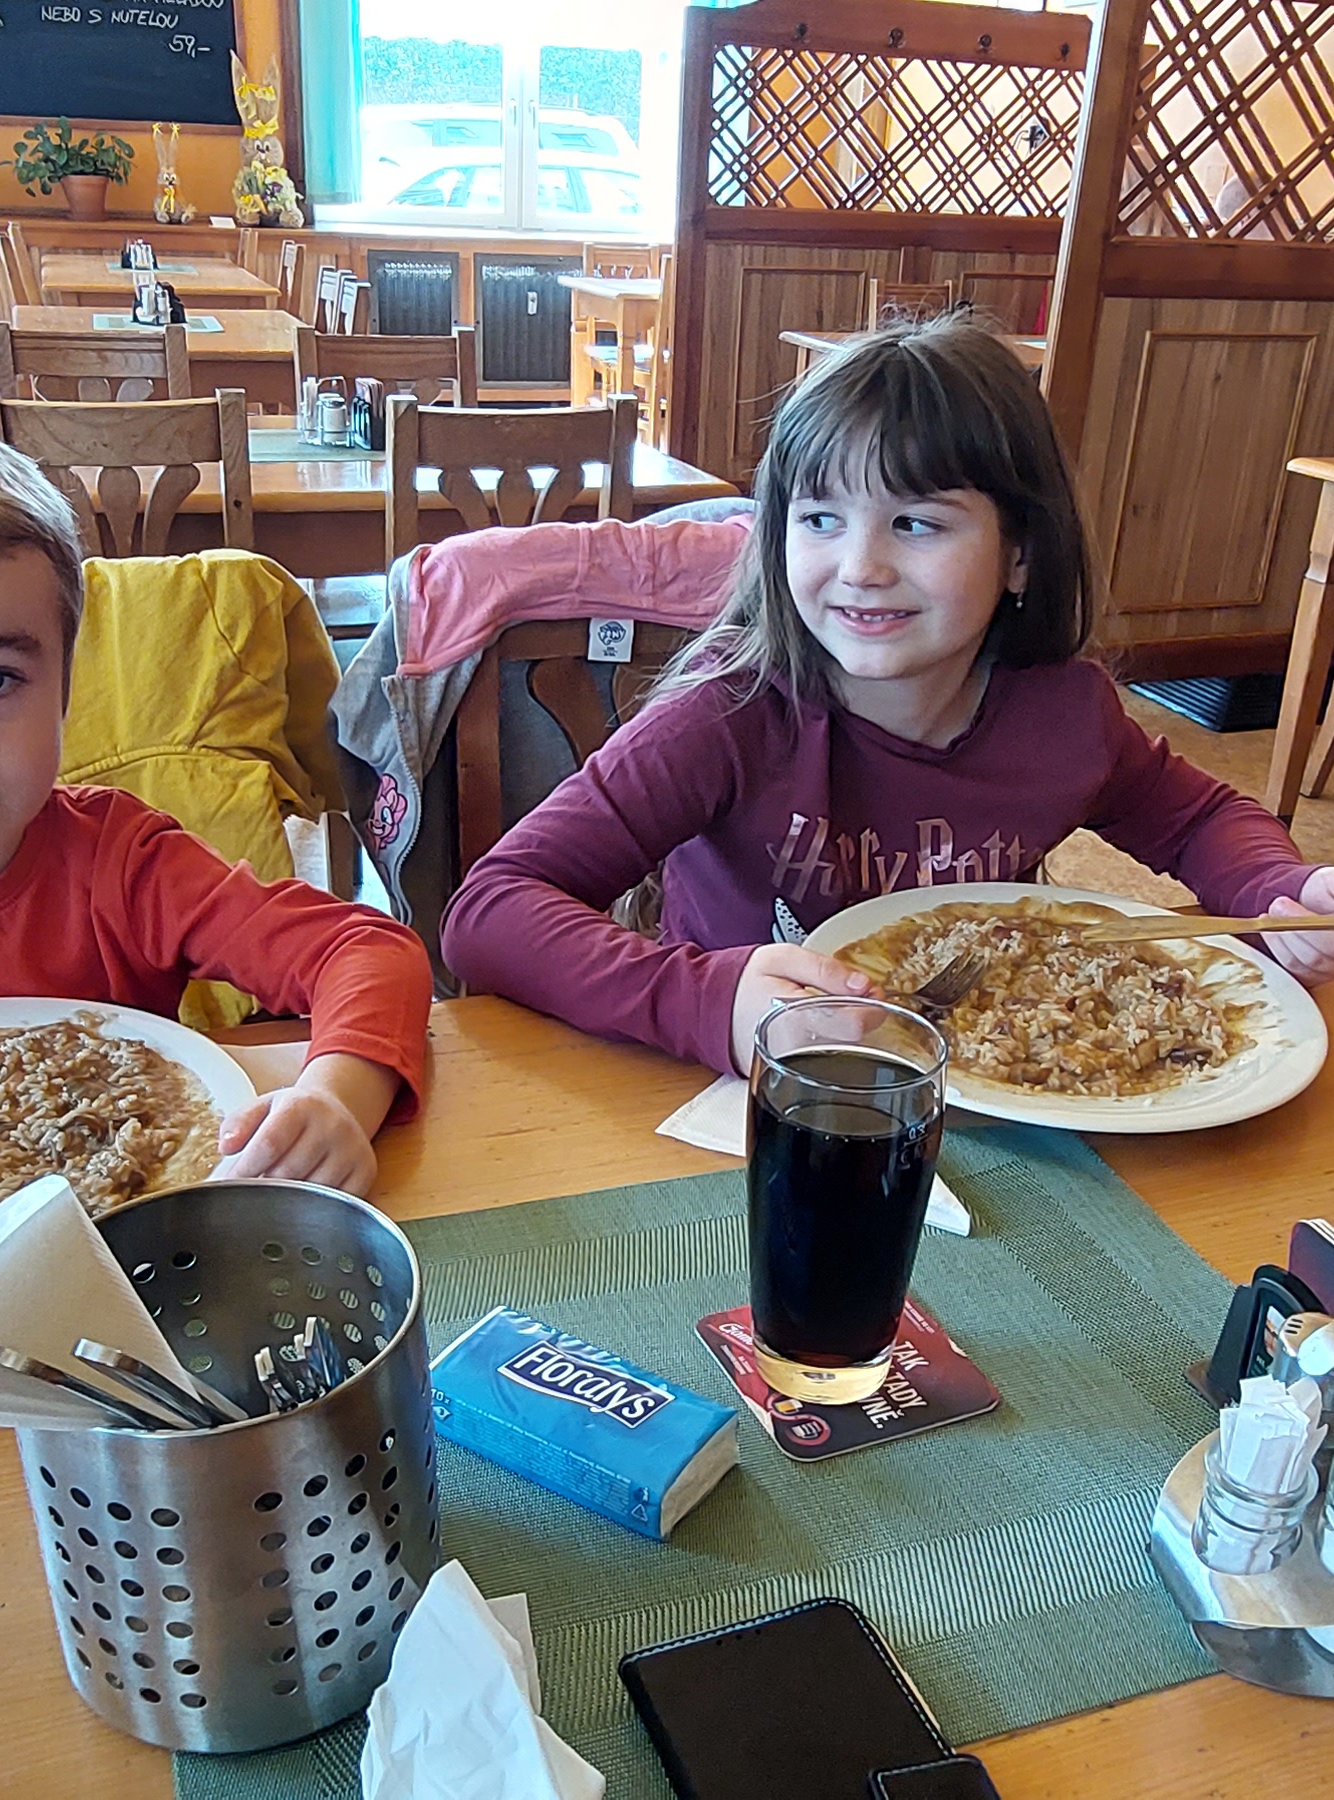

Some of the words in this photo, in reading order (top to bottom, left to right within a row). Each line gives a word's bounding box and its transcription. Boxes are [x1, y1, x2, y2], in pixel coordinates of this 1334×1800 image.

[41, 6, 81, 22] NEBO
[88, 9, 103, 24] S
[111, 9, 179, 29] NUTELOU
[766, 812, 908, 903] Harry
[894, 1340, 930, 1373] TAK
[513, 1348, 655, 1421] Floralys
